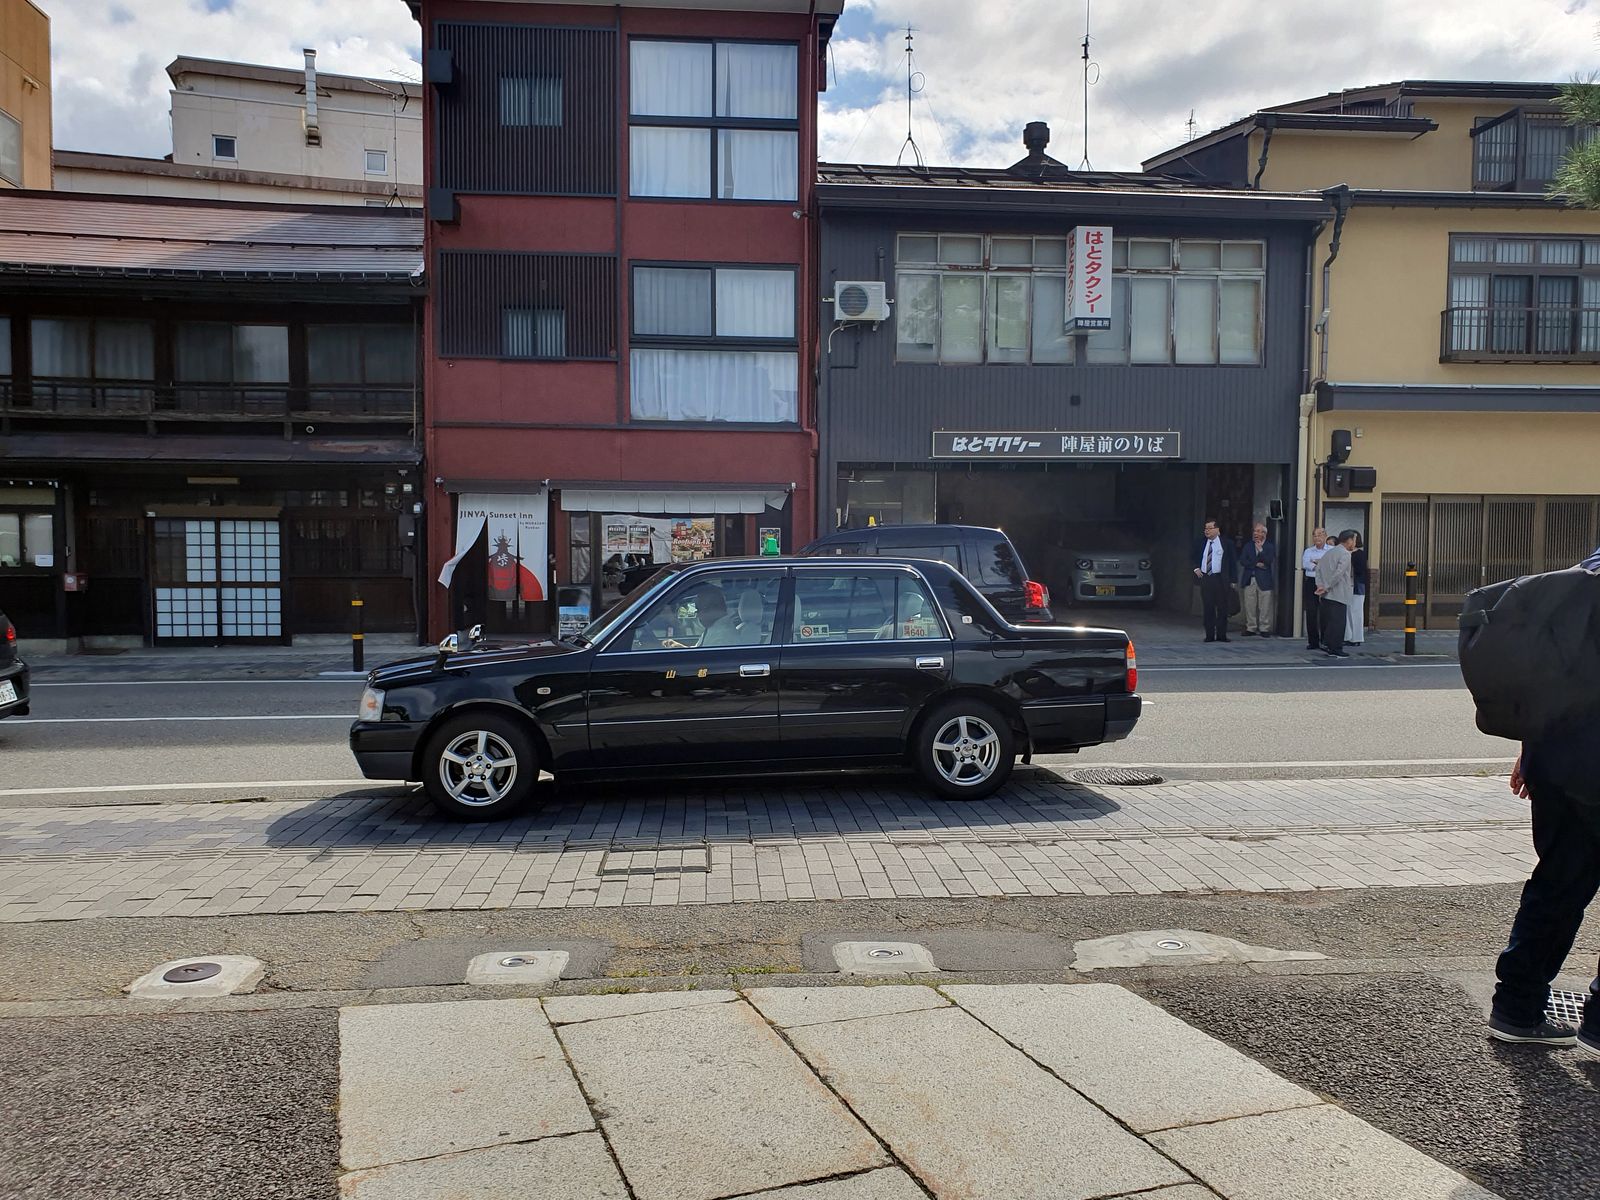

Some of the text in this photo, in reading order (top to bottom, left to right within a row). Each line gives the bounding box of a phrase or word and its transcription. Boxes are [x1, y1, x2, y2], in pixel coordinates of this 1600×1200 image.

[1085, 231, 1104, 313] はとタクシー
[952, 435, 1165, 453] はとタクシー 陣屋前のりば
[460, 511, 486, 519] JINYA
